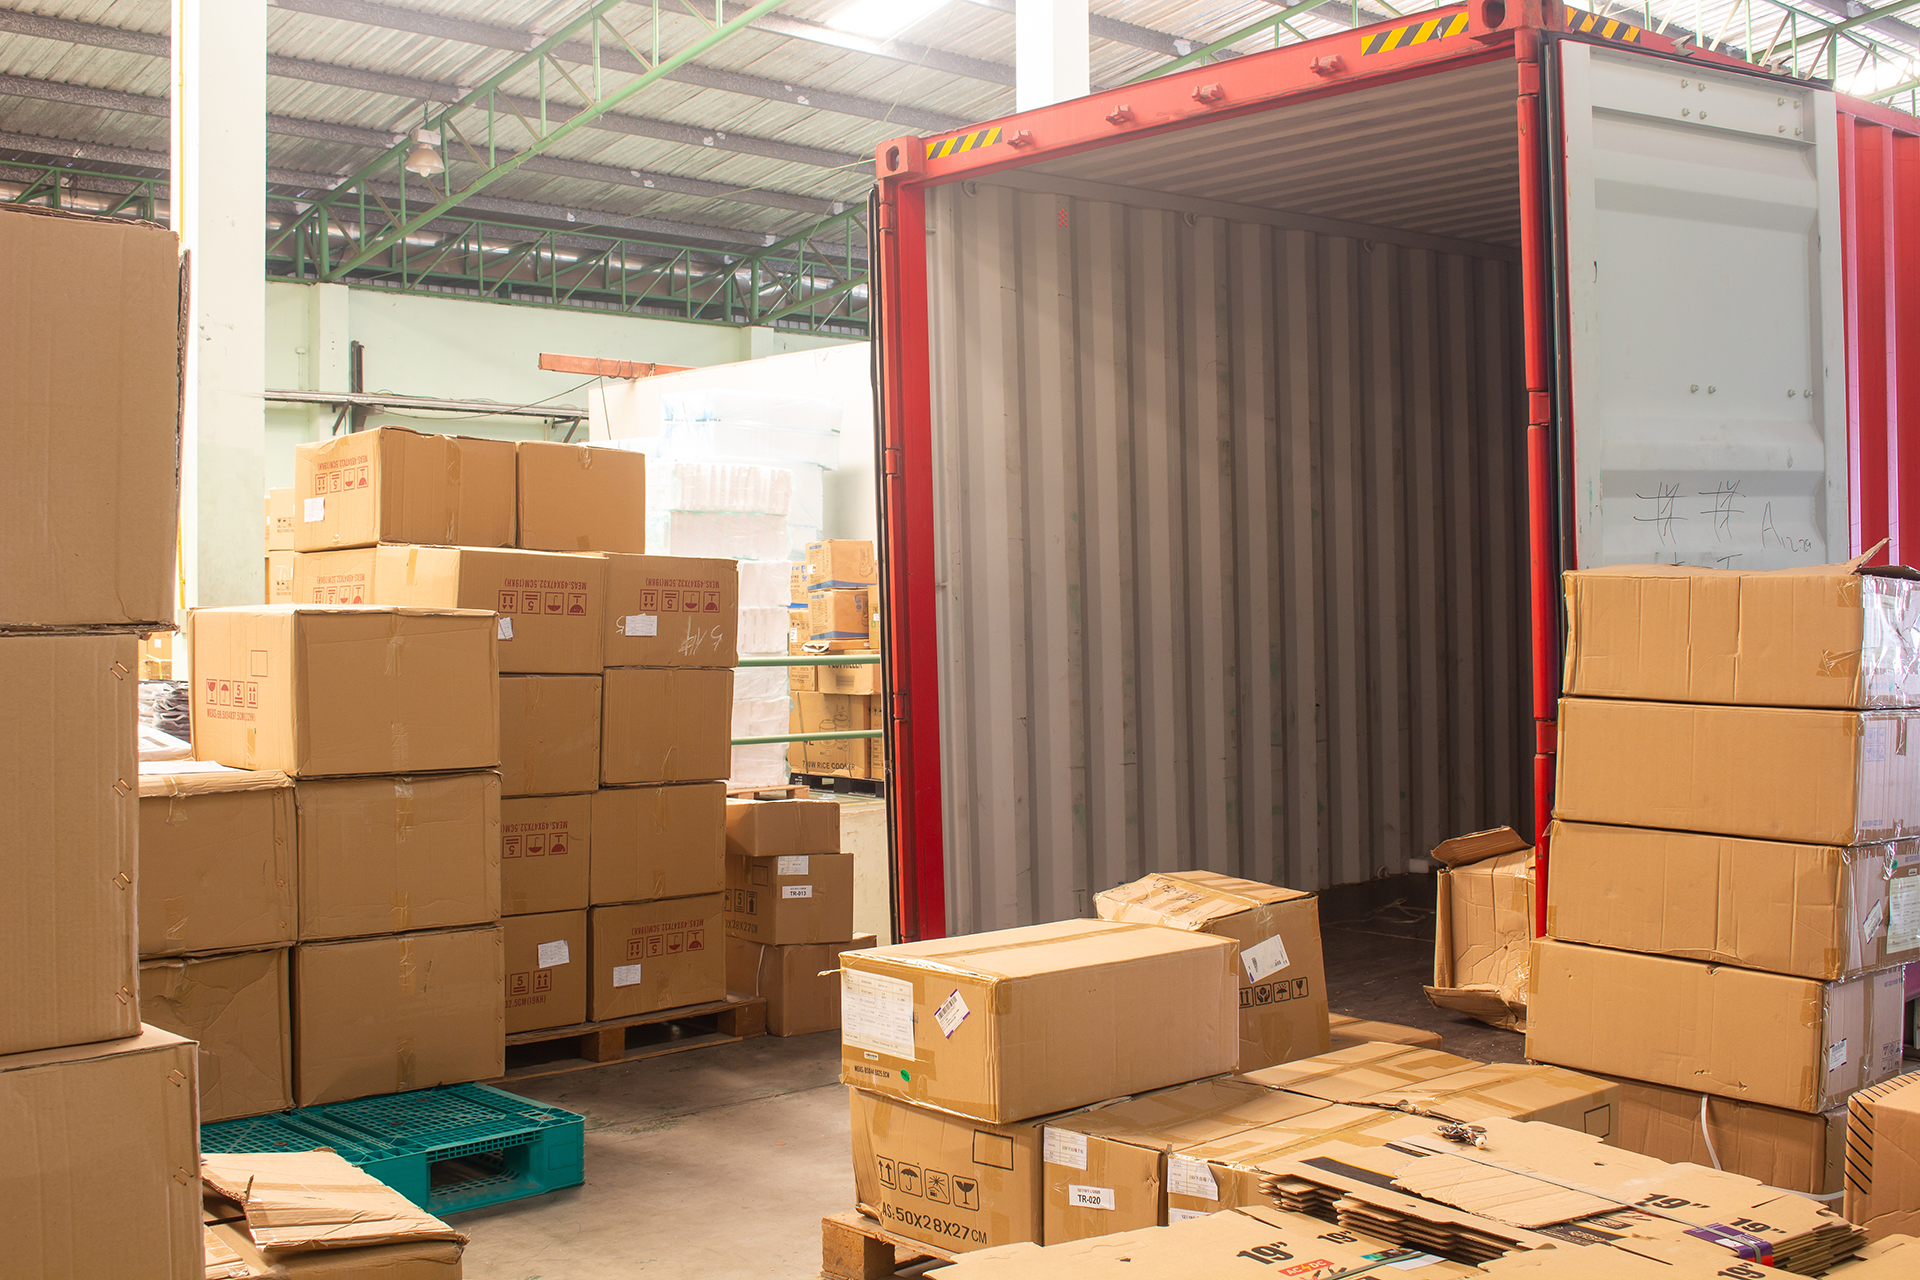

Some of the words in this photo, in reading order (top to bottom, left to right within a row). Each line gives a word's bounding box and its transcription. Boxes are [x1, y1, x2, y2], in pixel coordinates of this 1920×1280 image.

[504, 577, 587, 591] MEAS:49X47X32.5CM(19KH)
[645, 577, 720, 590] MEAS:49X47X32.5CM(19KH)
[527, 601, 534, 611] 5
[667, 599, 673, 609] 5
[817, 761, 830, 769] RICE
[508, 845, 515, 855] 5
[631, 918, 704, 935] MEAS:49X47X32.5CM(19KH)
[651, 944, 658, 954] 5
[517, 975, 523, 986] 5
[1077, 1194, 1101, 1205] TR-020
